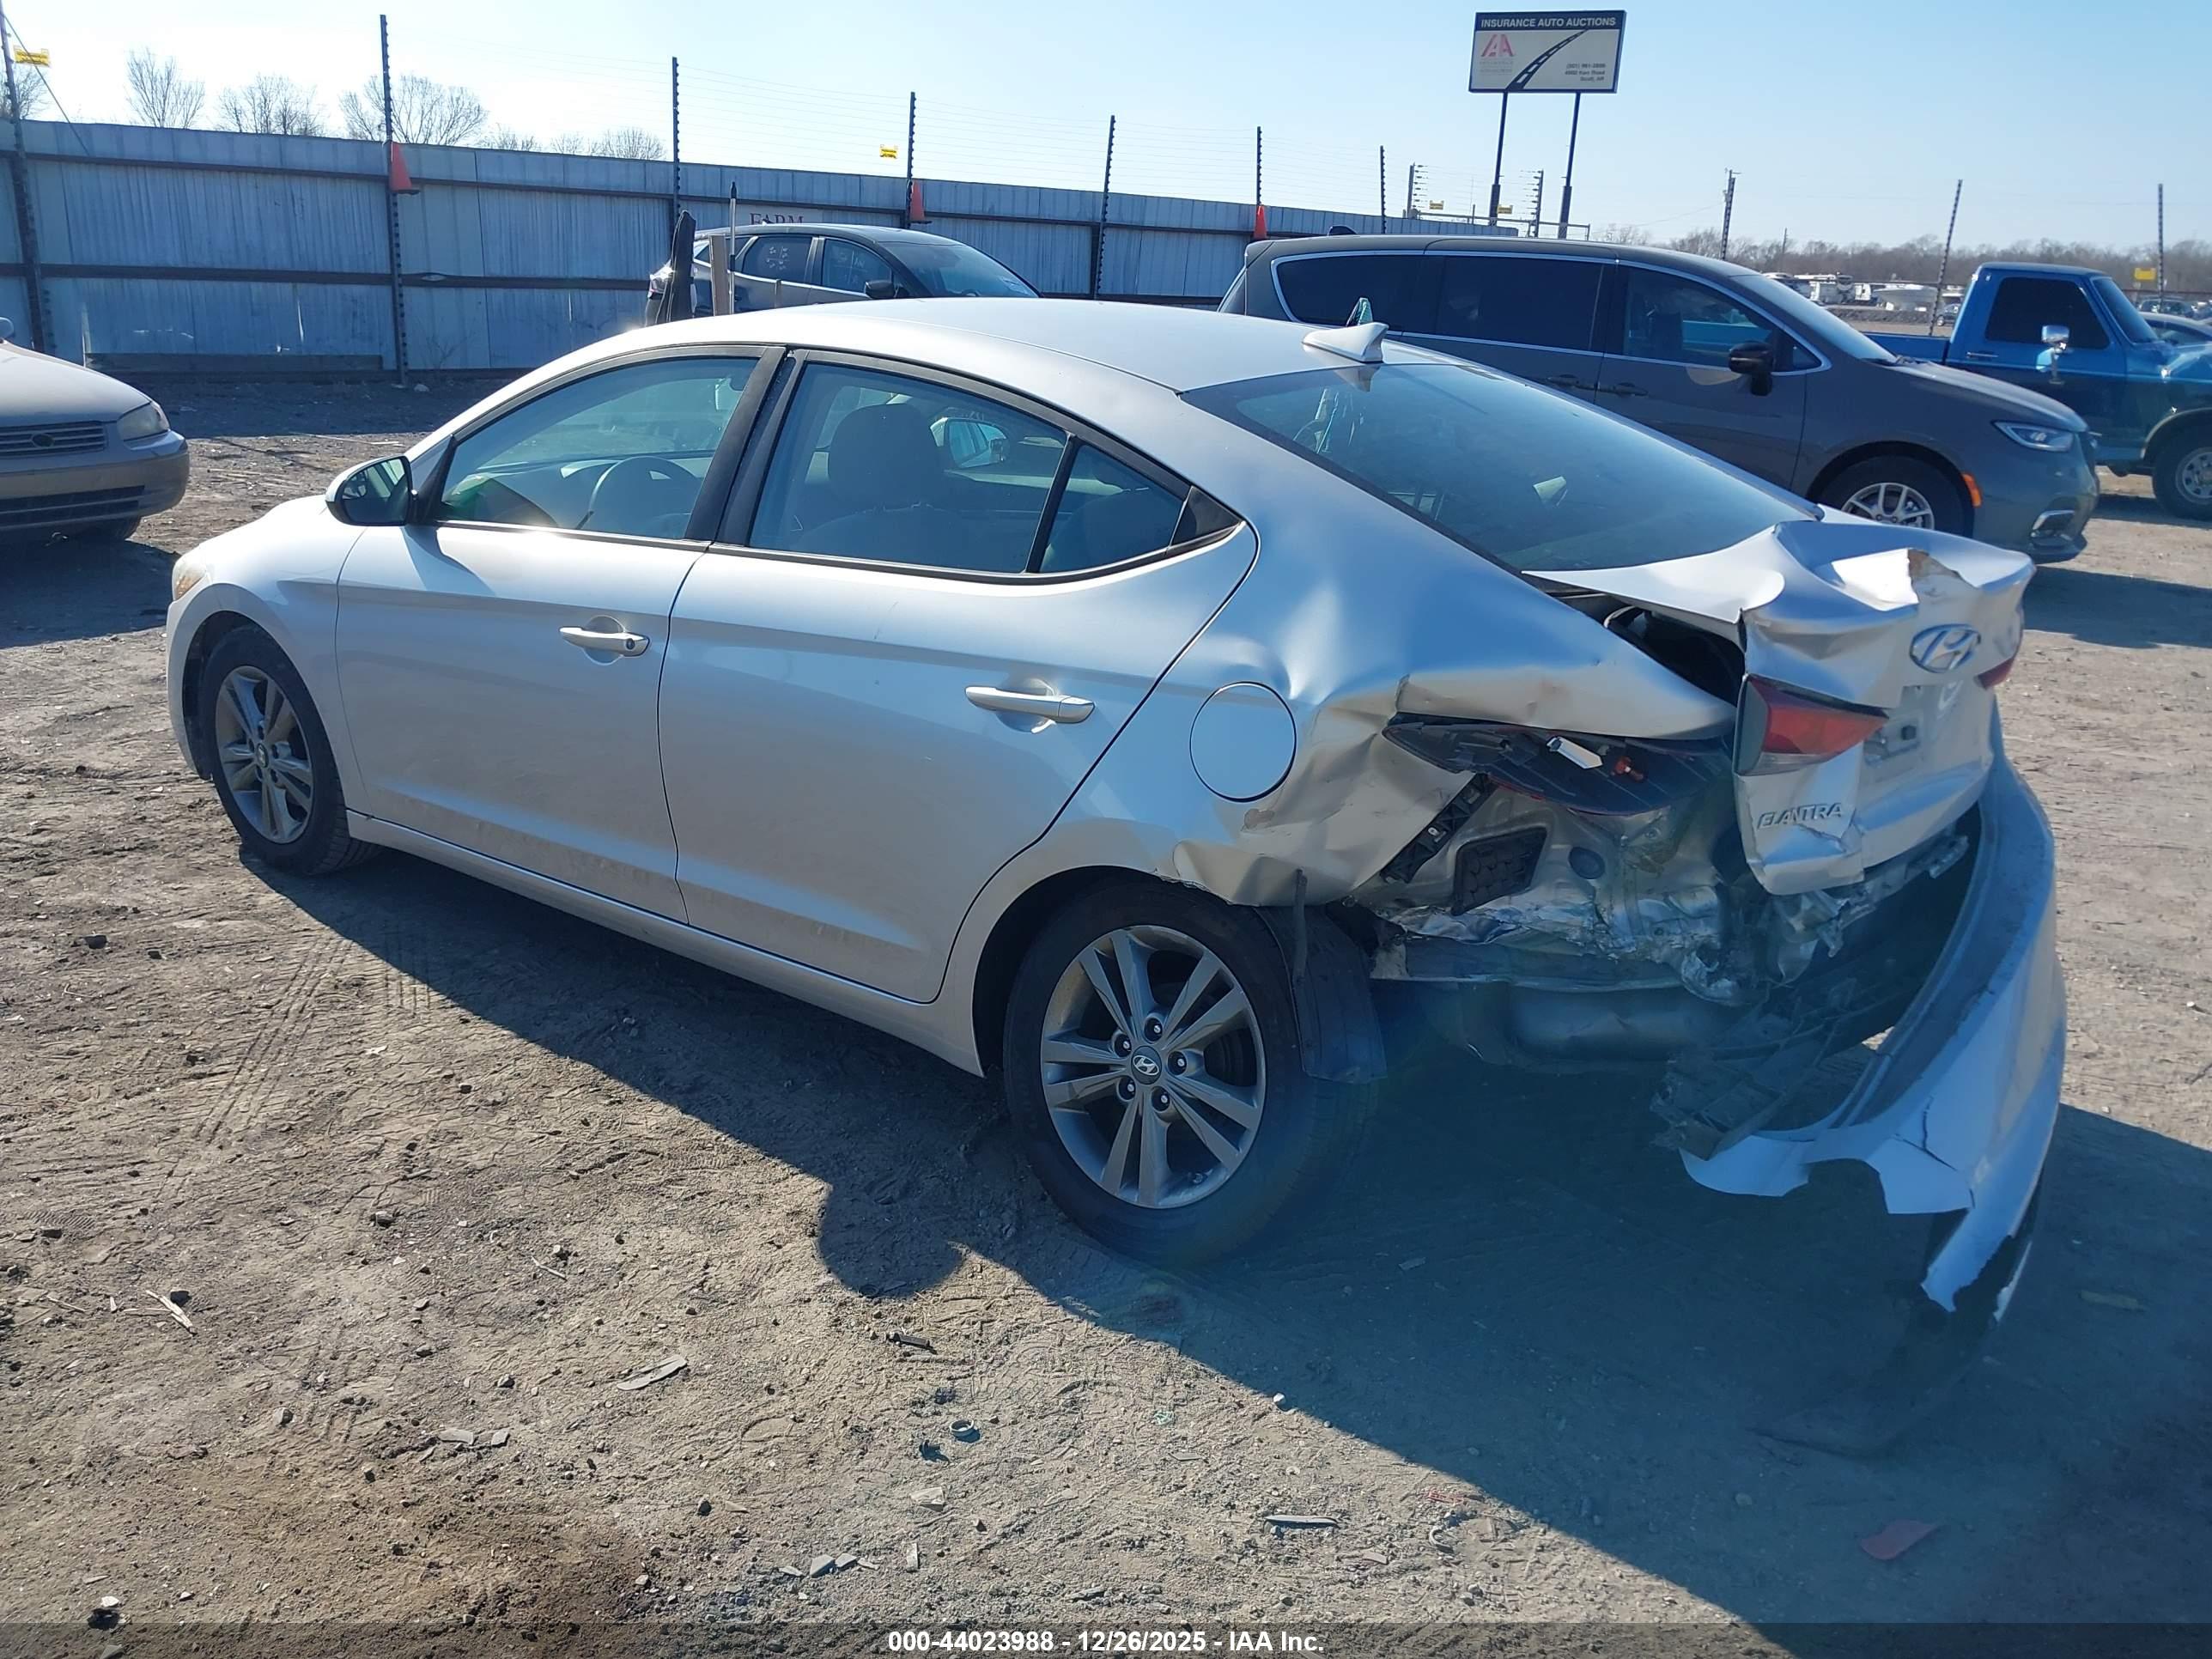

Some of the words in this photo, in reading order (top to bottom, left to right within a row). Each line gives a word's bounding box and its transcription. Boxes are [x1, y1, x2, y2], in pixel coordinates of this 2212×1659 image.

[1481, 18, 1536, 28] INSURANCE
[1537, 17, 1565, 27] AUTO
[1565, 17, 1617, 27] AUCTIONS
